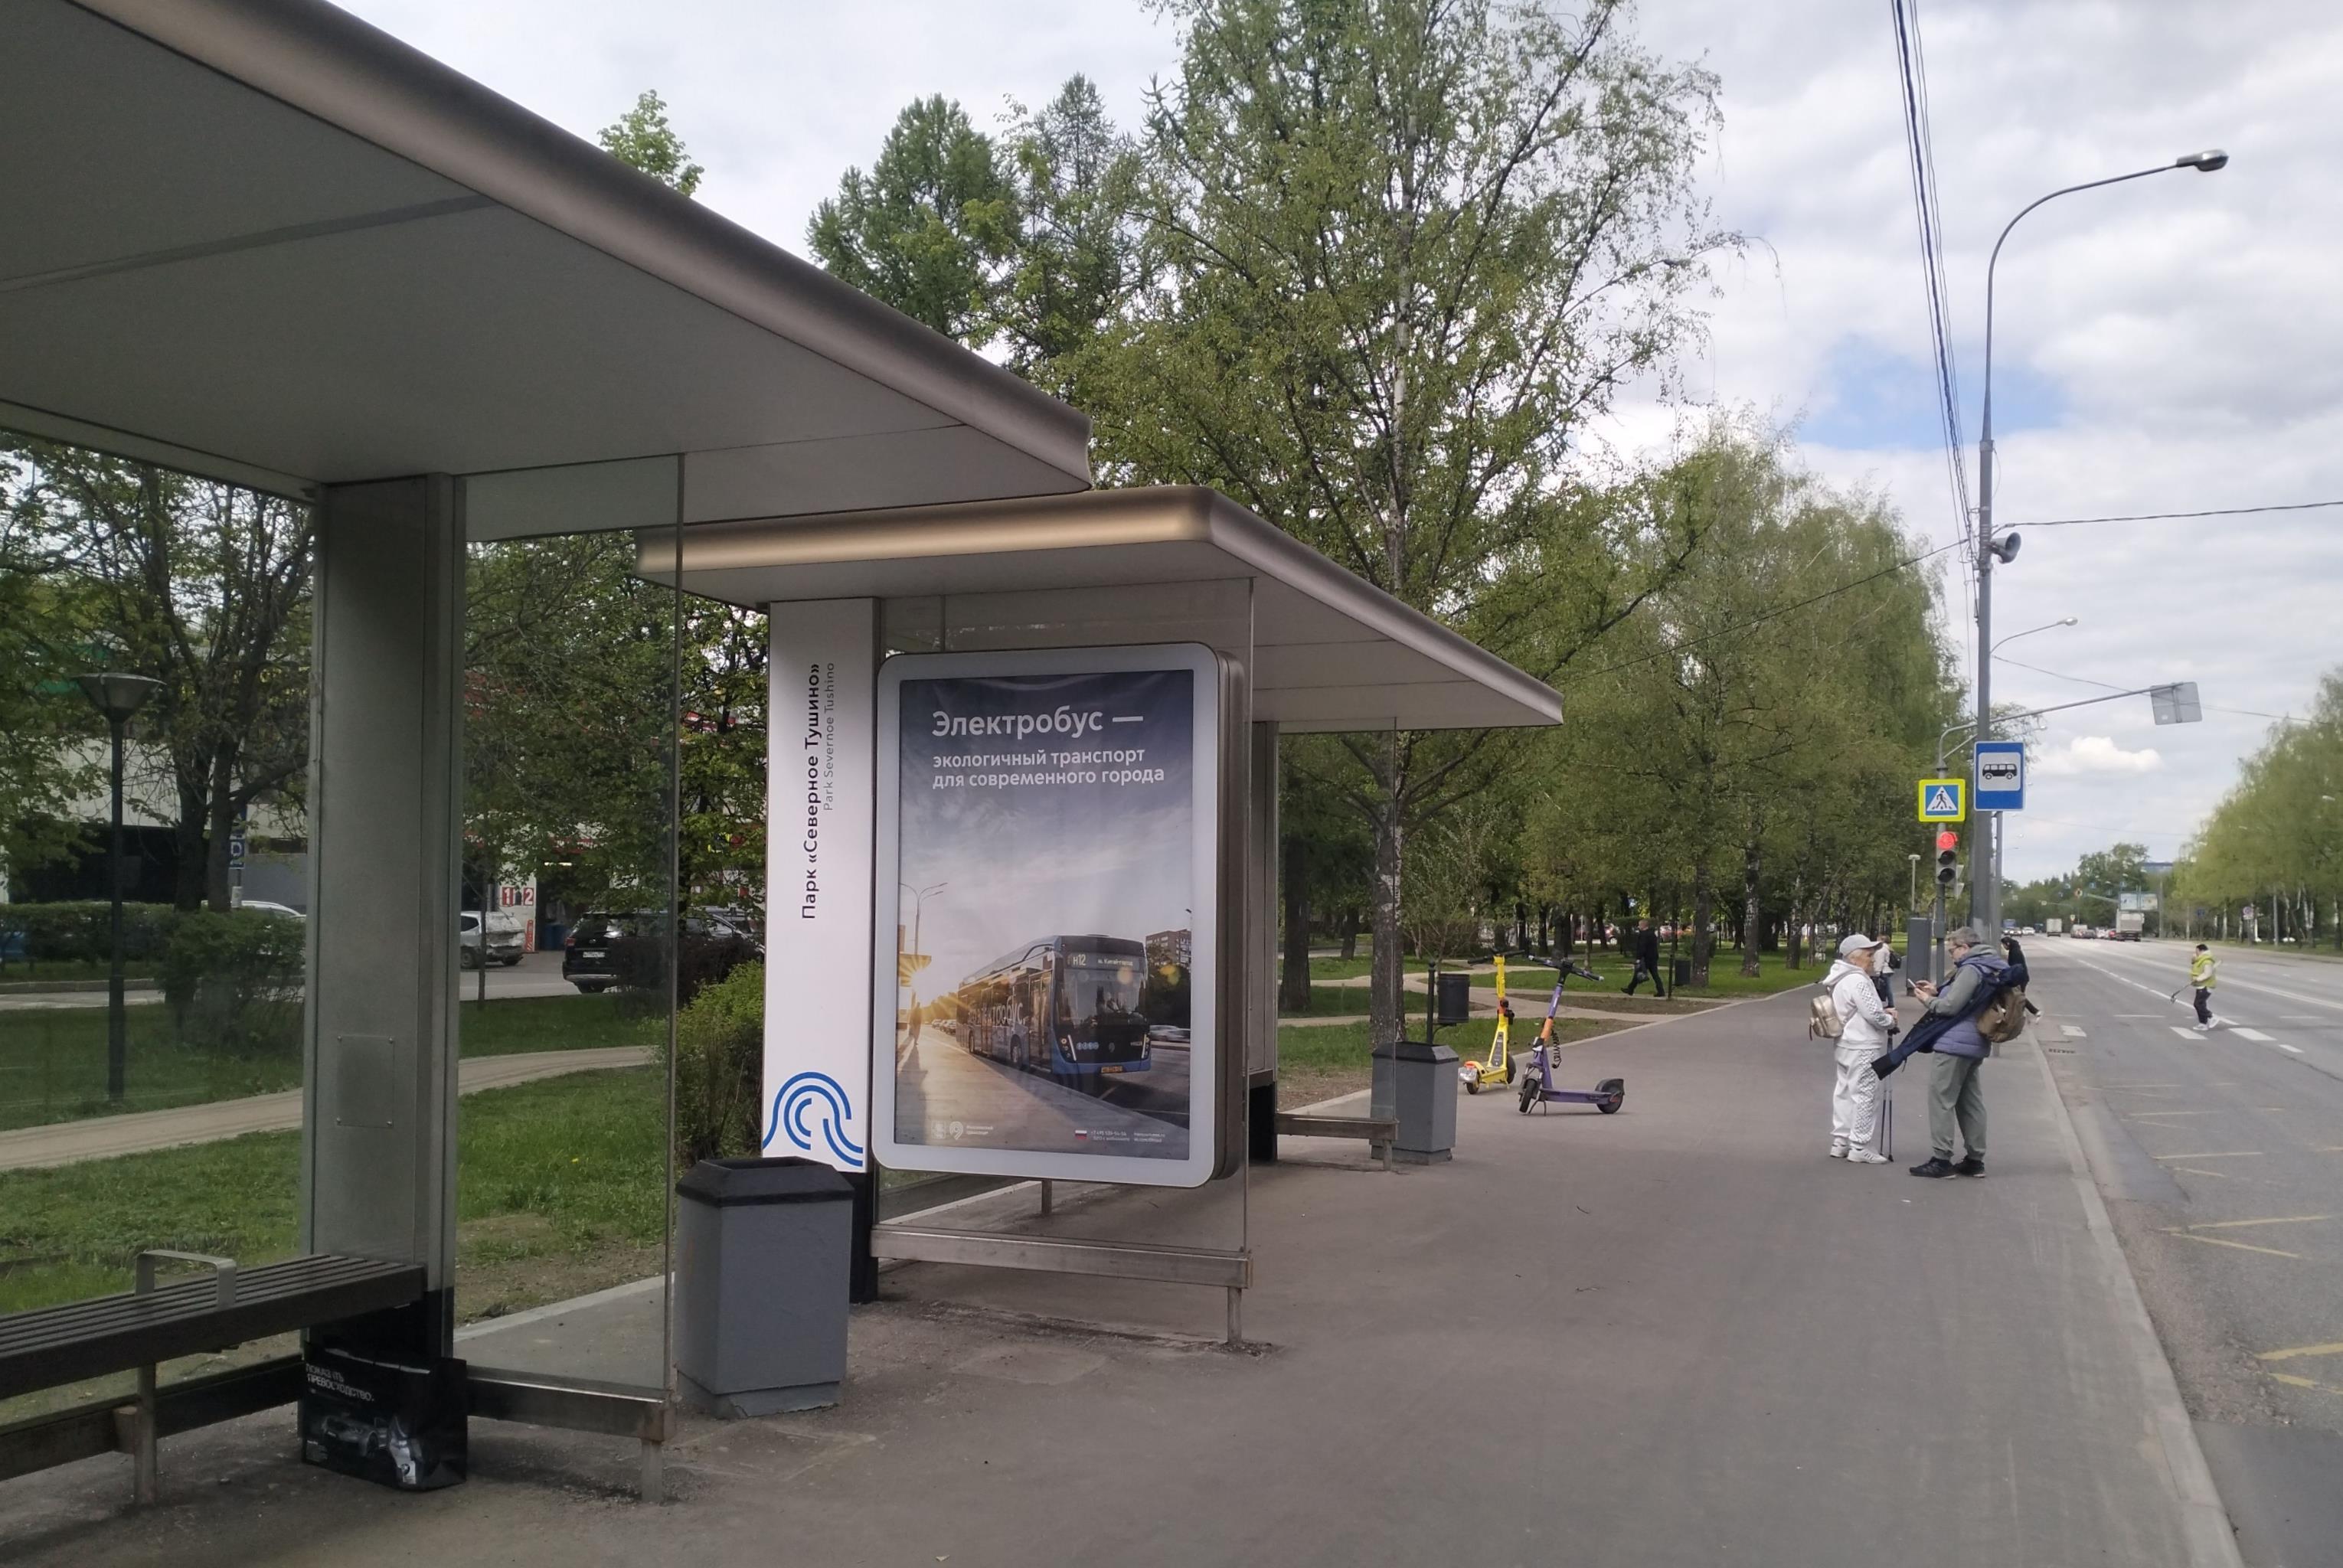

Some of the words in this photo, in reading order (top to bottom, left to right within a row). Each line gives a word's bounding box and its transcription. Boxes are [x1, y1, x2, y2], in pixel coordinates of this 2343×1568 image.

[804, 664, 822, 750] Тушино»
[823, 662, 835, 713] Tushino
[932, 704, 1103, 740] Электробус
[823, 716, 835, 778] Severnoe
[933, 748, 1047, 769] экологичный
[1051, 747, 1145, 768] транспорт
[823, 781, 834, 811] Park
[932, 772, 965, 790] для
[969, 769, 1096, 789] современного
[1101, 766, 1165, 786] города
[803, 755, 822, 864] «Северное
[524, 888, 533, 905] 2
[802, 868, 820, 919] Парк
